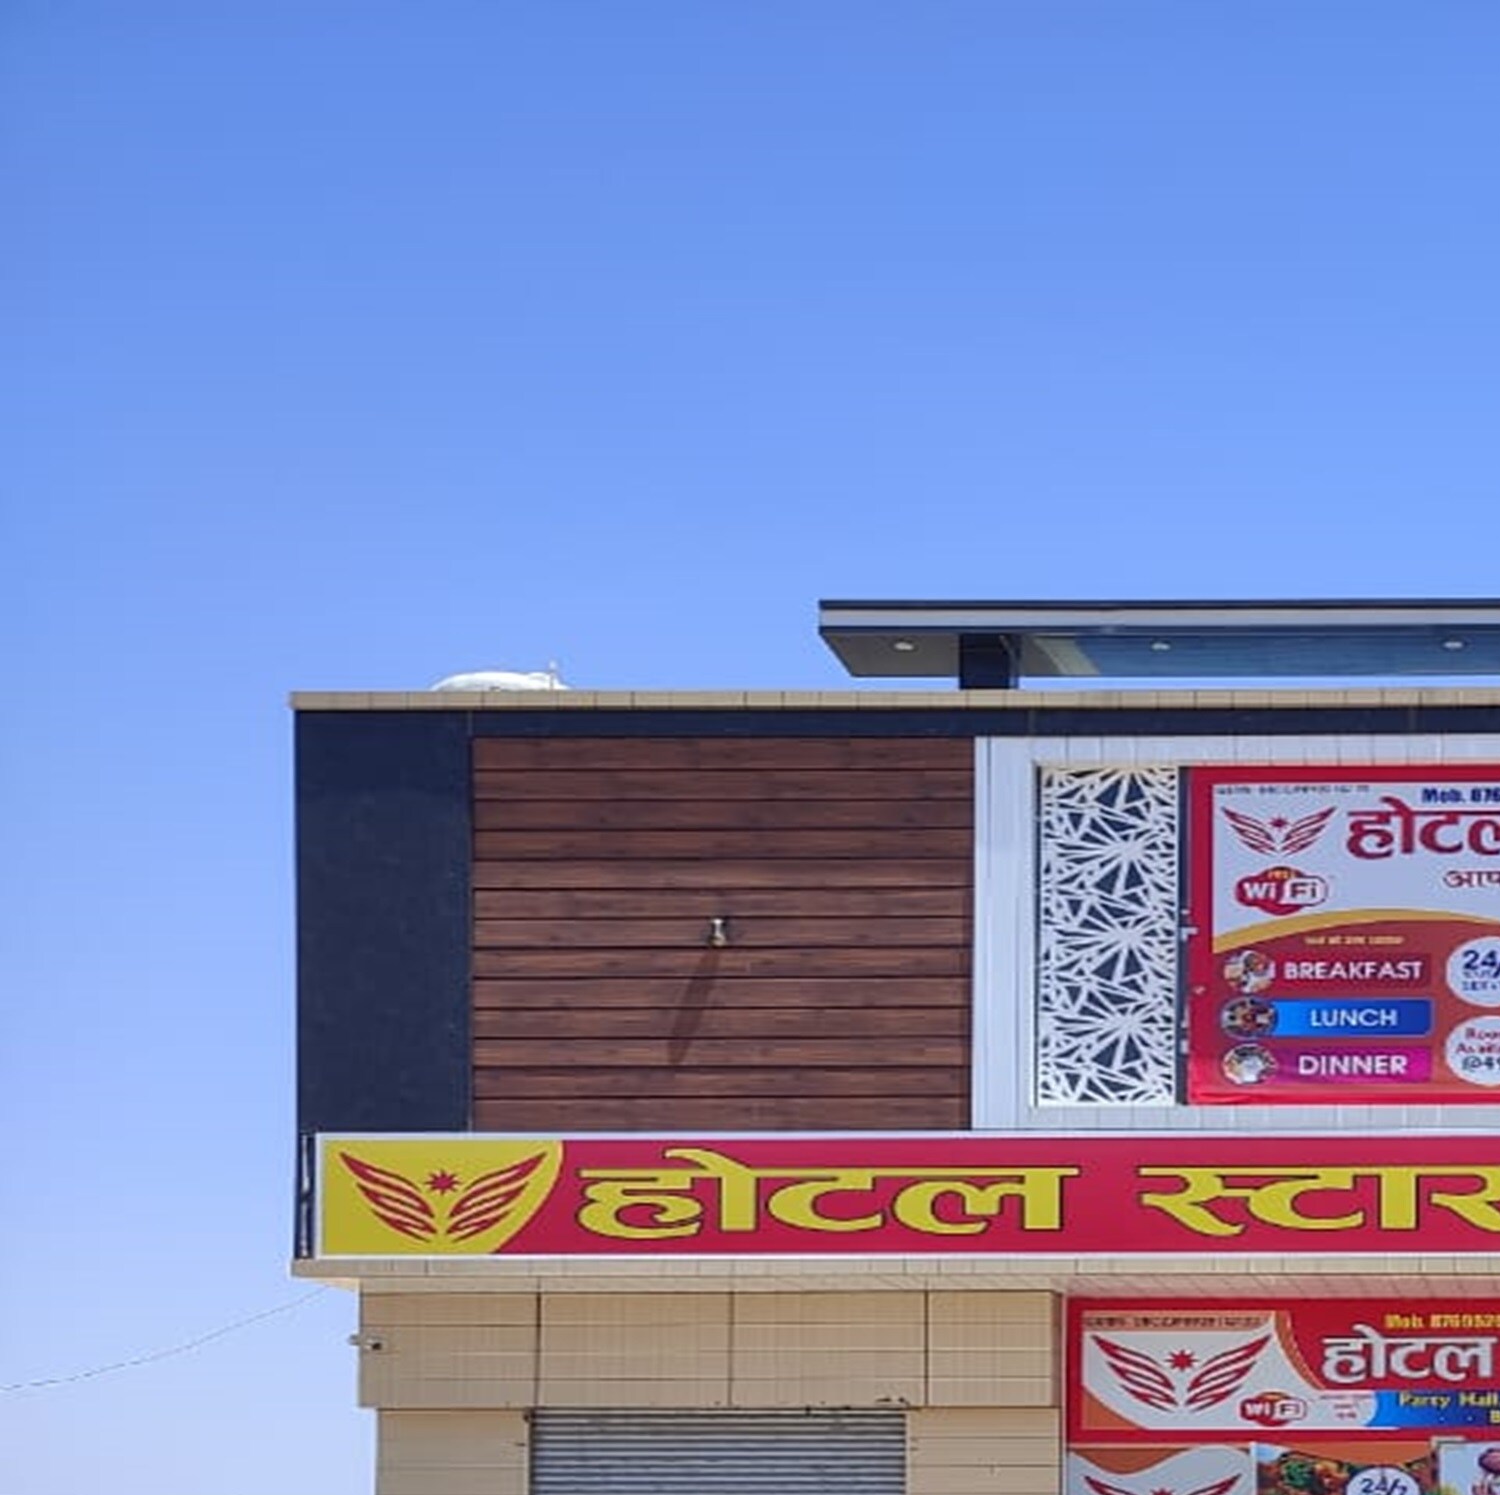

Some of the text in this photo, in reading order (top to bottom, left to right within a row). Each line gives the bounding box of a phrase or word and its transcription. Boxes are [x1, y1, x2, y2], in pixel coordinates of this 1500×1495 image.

[1284, 961, 1423, 981] BREAKFAST
[1310, 1008, 1398, 1027] LUNCH
[1298, 1054, 1408, 1076] DINNER
[576, 1148, 1080, 1240] होटल
[1321, 1324, 1498, 1384] होटल
